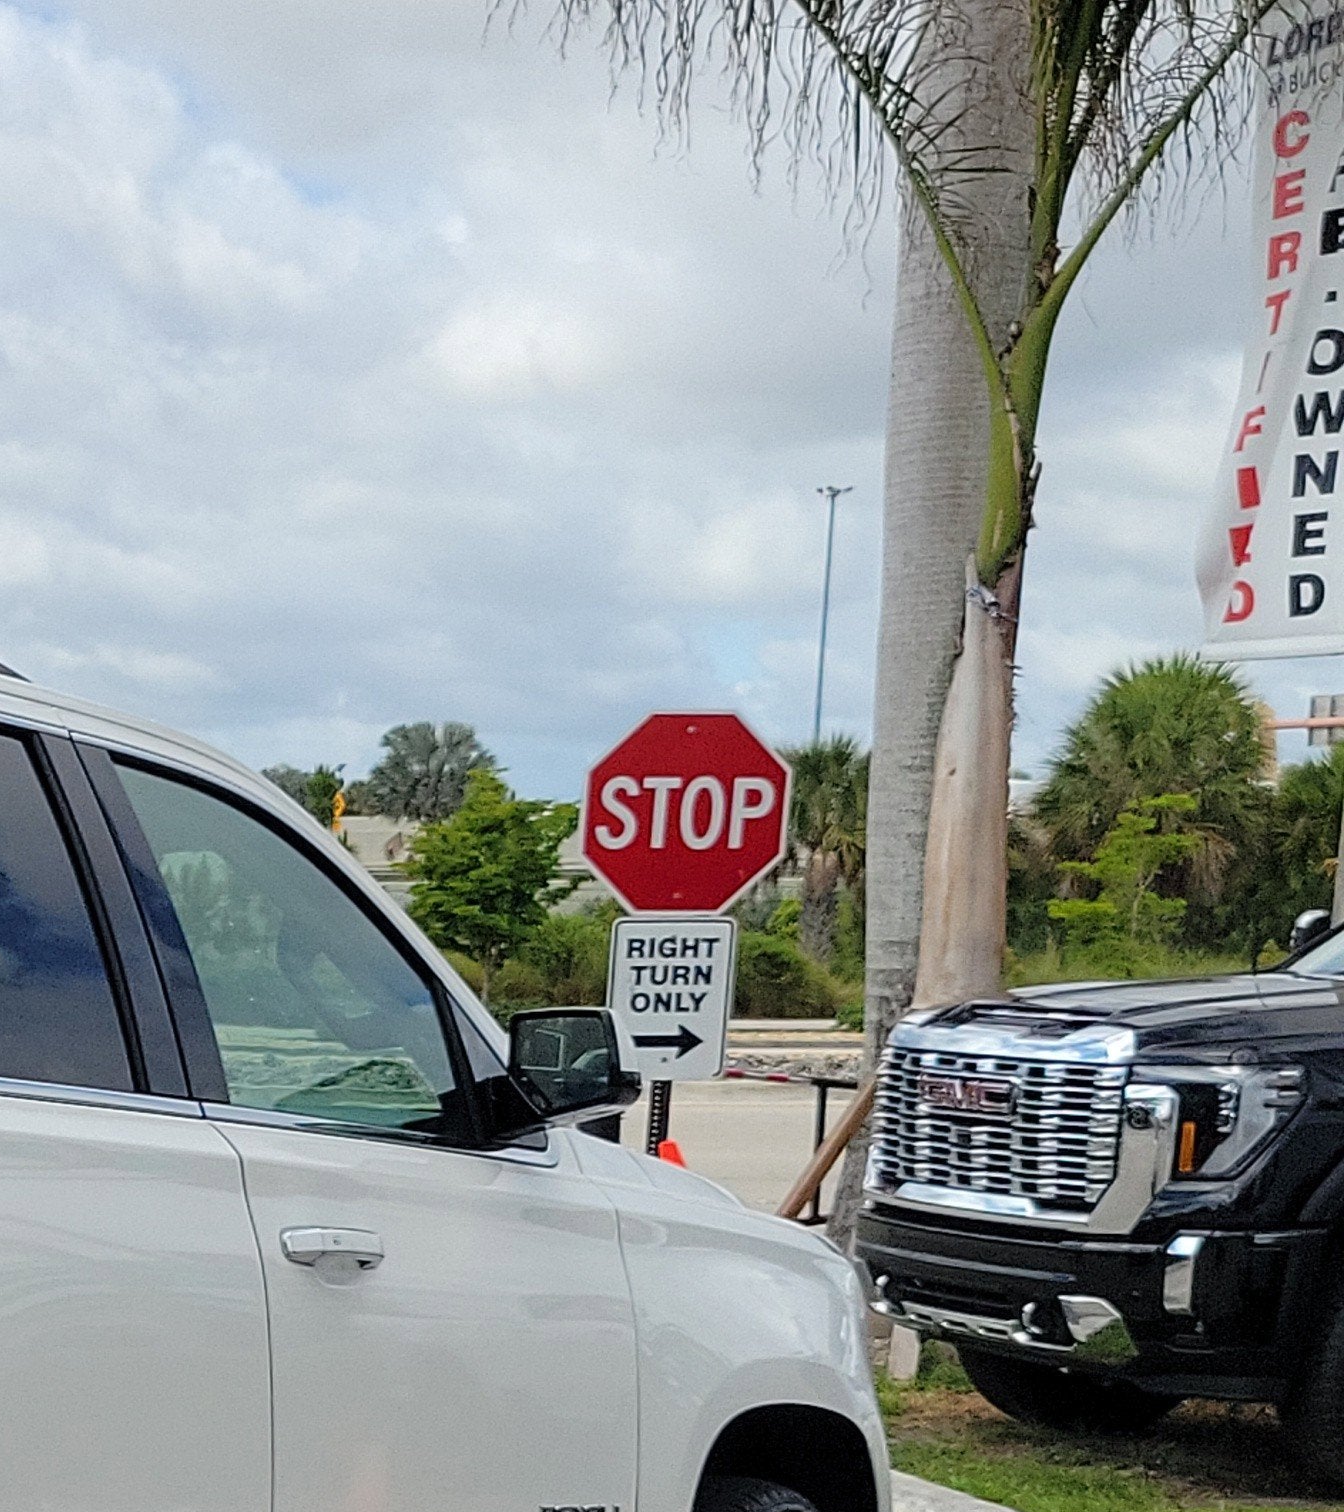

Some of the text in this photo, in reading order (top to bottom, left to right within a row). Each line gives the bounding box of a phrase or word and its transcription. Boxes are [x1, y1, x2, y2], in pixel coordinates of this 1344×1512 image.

[593, 775, 776, 851] STOP
[626, 937, 721, 960] RIGHT
[630, 965, 713, 986] TURN
[629, 992, 708, 1014] ONLY
[918, 1076, 1017, 1113] GMC
